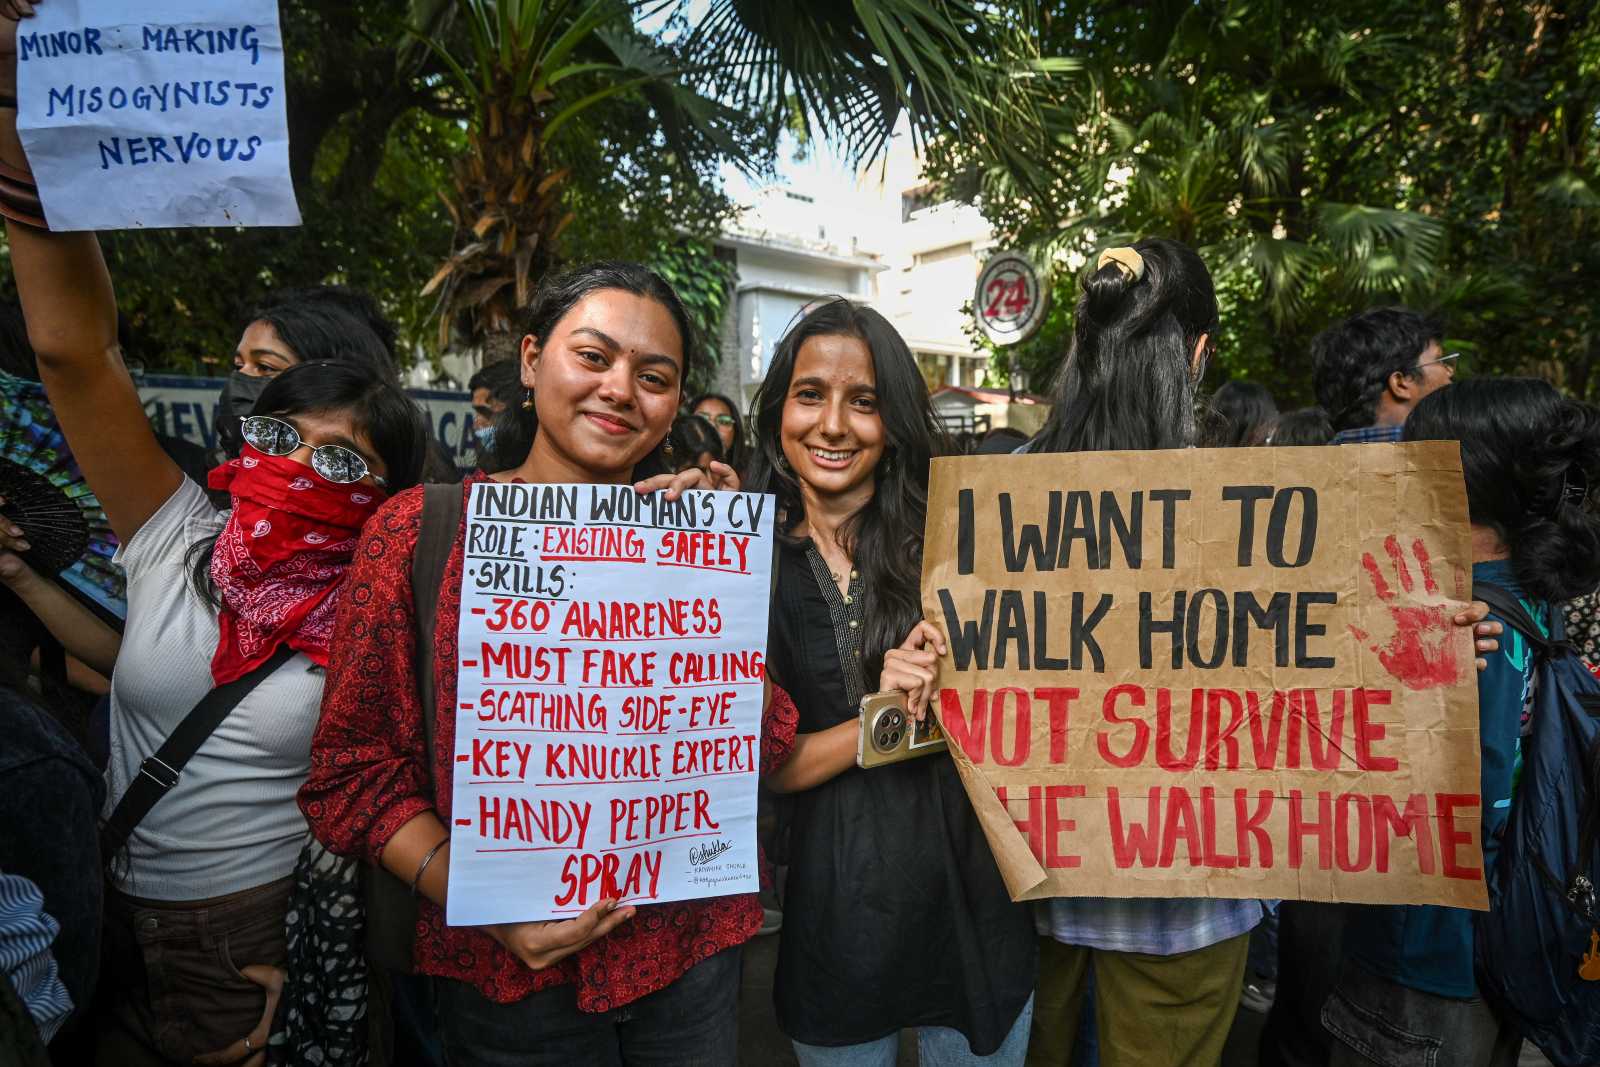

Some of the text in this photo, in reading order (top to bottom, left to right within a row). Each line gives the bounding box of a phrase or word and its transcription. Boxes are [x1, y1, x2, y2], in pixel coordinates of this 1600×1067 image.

[142, 24, 259, 65] MAKING
[46, 80, 274, 117] MISOGYNISTS
[98, 132, 262, 169] NERVOUS
[984, 272, 1031, 317] 24
[475, 485, 766, 533] INDIAN WOMAN'S CV
[957, 485, 1318, 575] I WANT TO
[541, 525, 645, 558] EXISTING
[656, 530, 750, 571] SAFELY
[560, 597, 722, 640] AWARENESS
[937, 587, 1338, 673] WALK HOME
[581, 648, 657, 687] FAKE
[668, 650, 766, 684] CALLING
[619, 691, 737, 733] SIDE-EYE
[939, 683, 1399, 772] NOT SURVIVE
[545, 743, 661, 780] KNUCKLE
[671, 735, 757, 775] EXPERT
[609, 789, 720, 845] PEPPER
[992, 784, 1482, 880] HE WALK HOME
[554, 850, 662, 906] SPRAY
